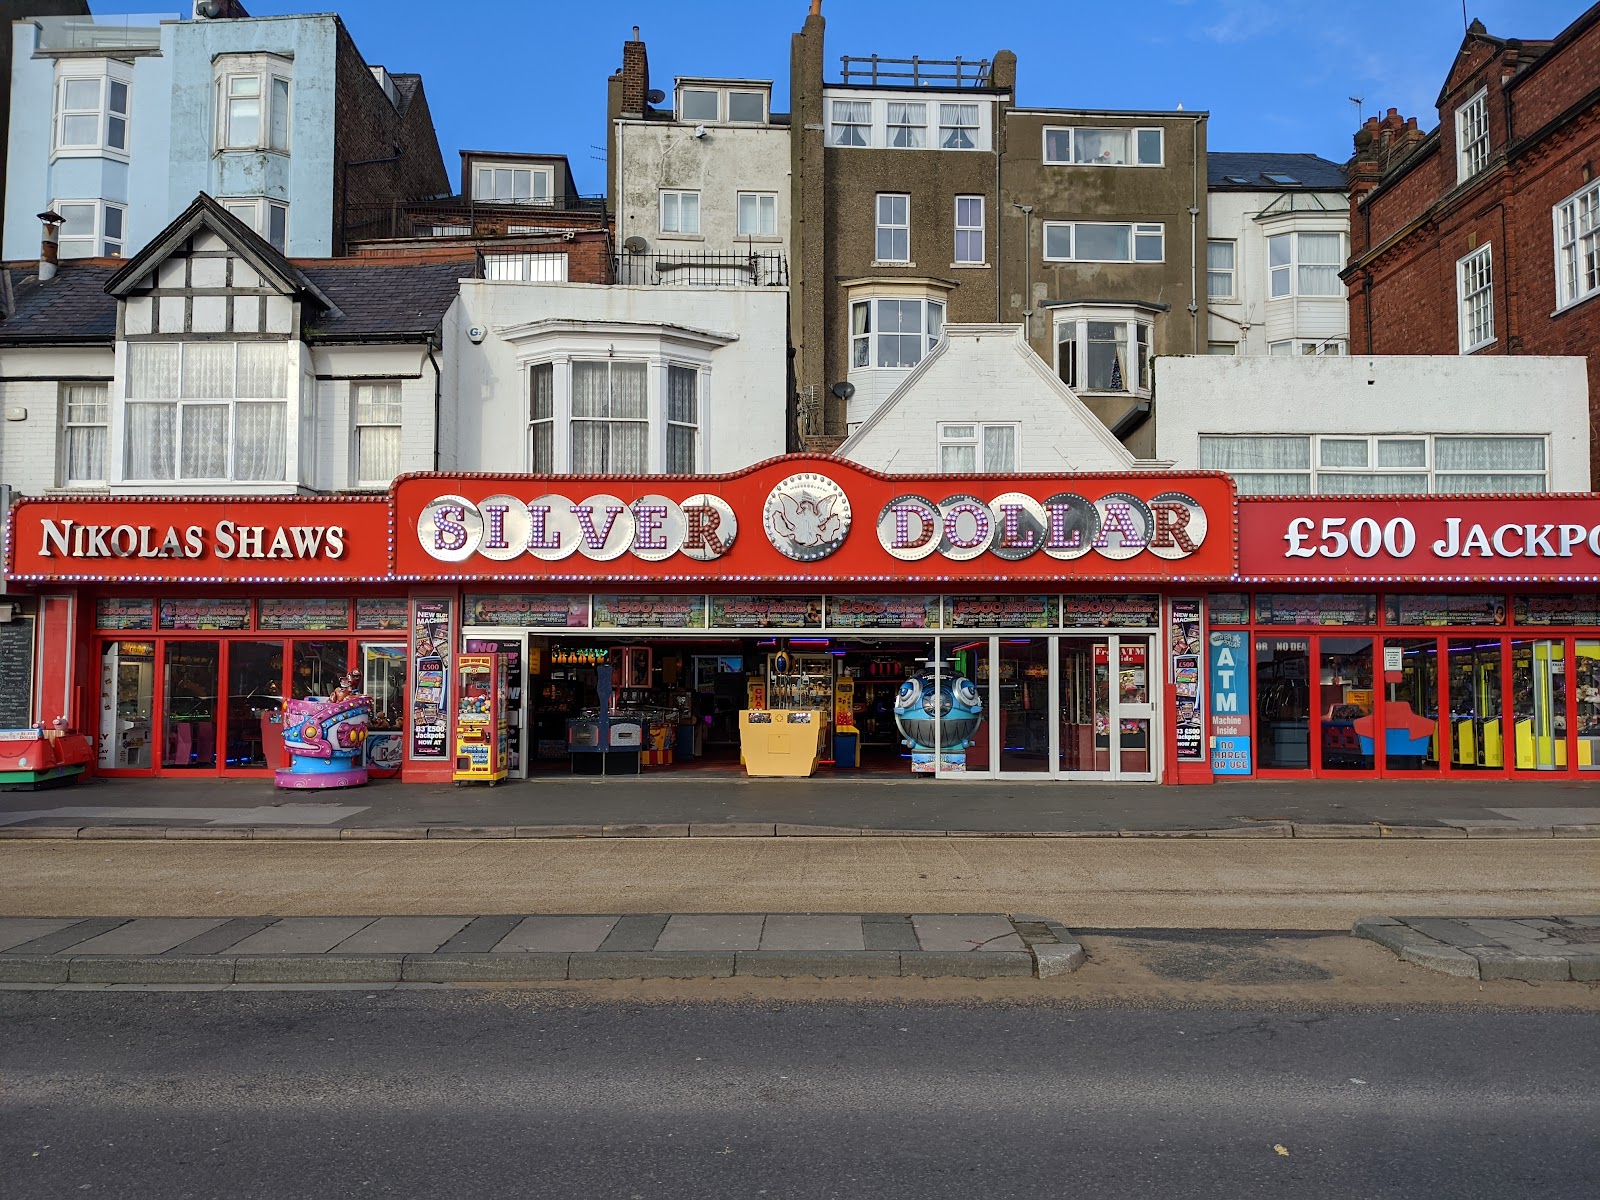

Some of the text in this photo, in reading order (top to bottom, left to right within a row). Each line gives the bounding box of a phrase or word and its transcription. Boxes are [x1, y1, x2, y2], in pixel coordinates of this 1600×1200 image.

[433, 502, 1198, 553] SILVER DOLLAR
[37, 519, 344, 559] NIKOLAS SHAWS
[1284, 517, 1416, 558] £500
[724, 602, 768, 613] £500
[840, 602, 885, 613] £500
[958, 602, 1004, 613] £500
[474, 642, 499, 653] NO
[1256, 642, 1268, 651] OR
[1276, 642, 1289, 651] NO
[422, 663, 440, 671] £500
[1216, 648, 1237, 712] ATM
[1212, 716, 1242, 725] Machine
[427, 725, 445, 733] £500
[1216, 726, 1238, 735] Inside
[415, 732, 446, 740] Jackpots
[1221, 741, 1234, 749] NO
